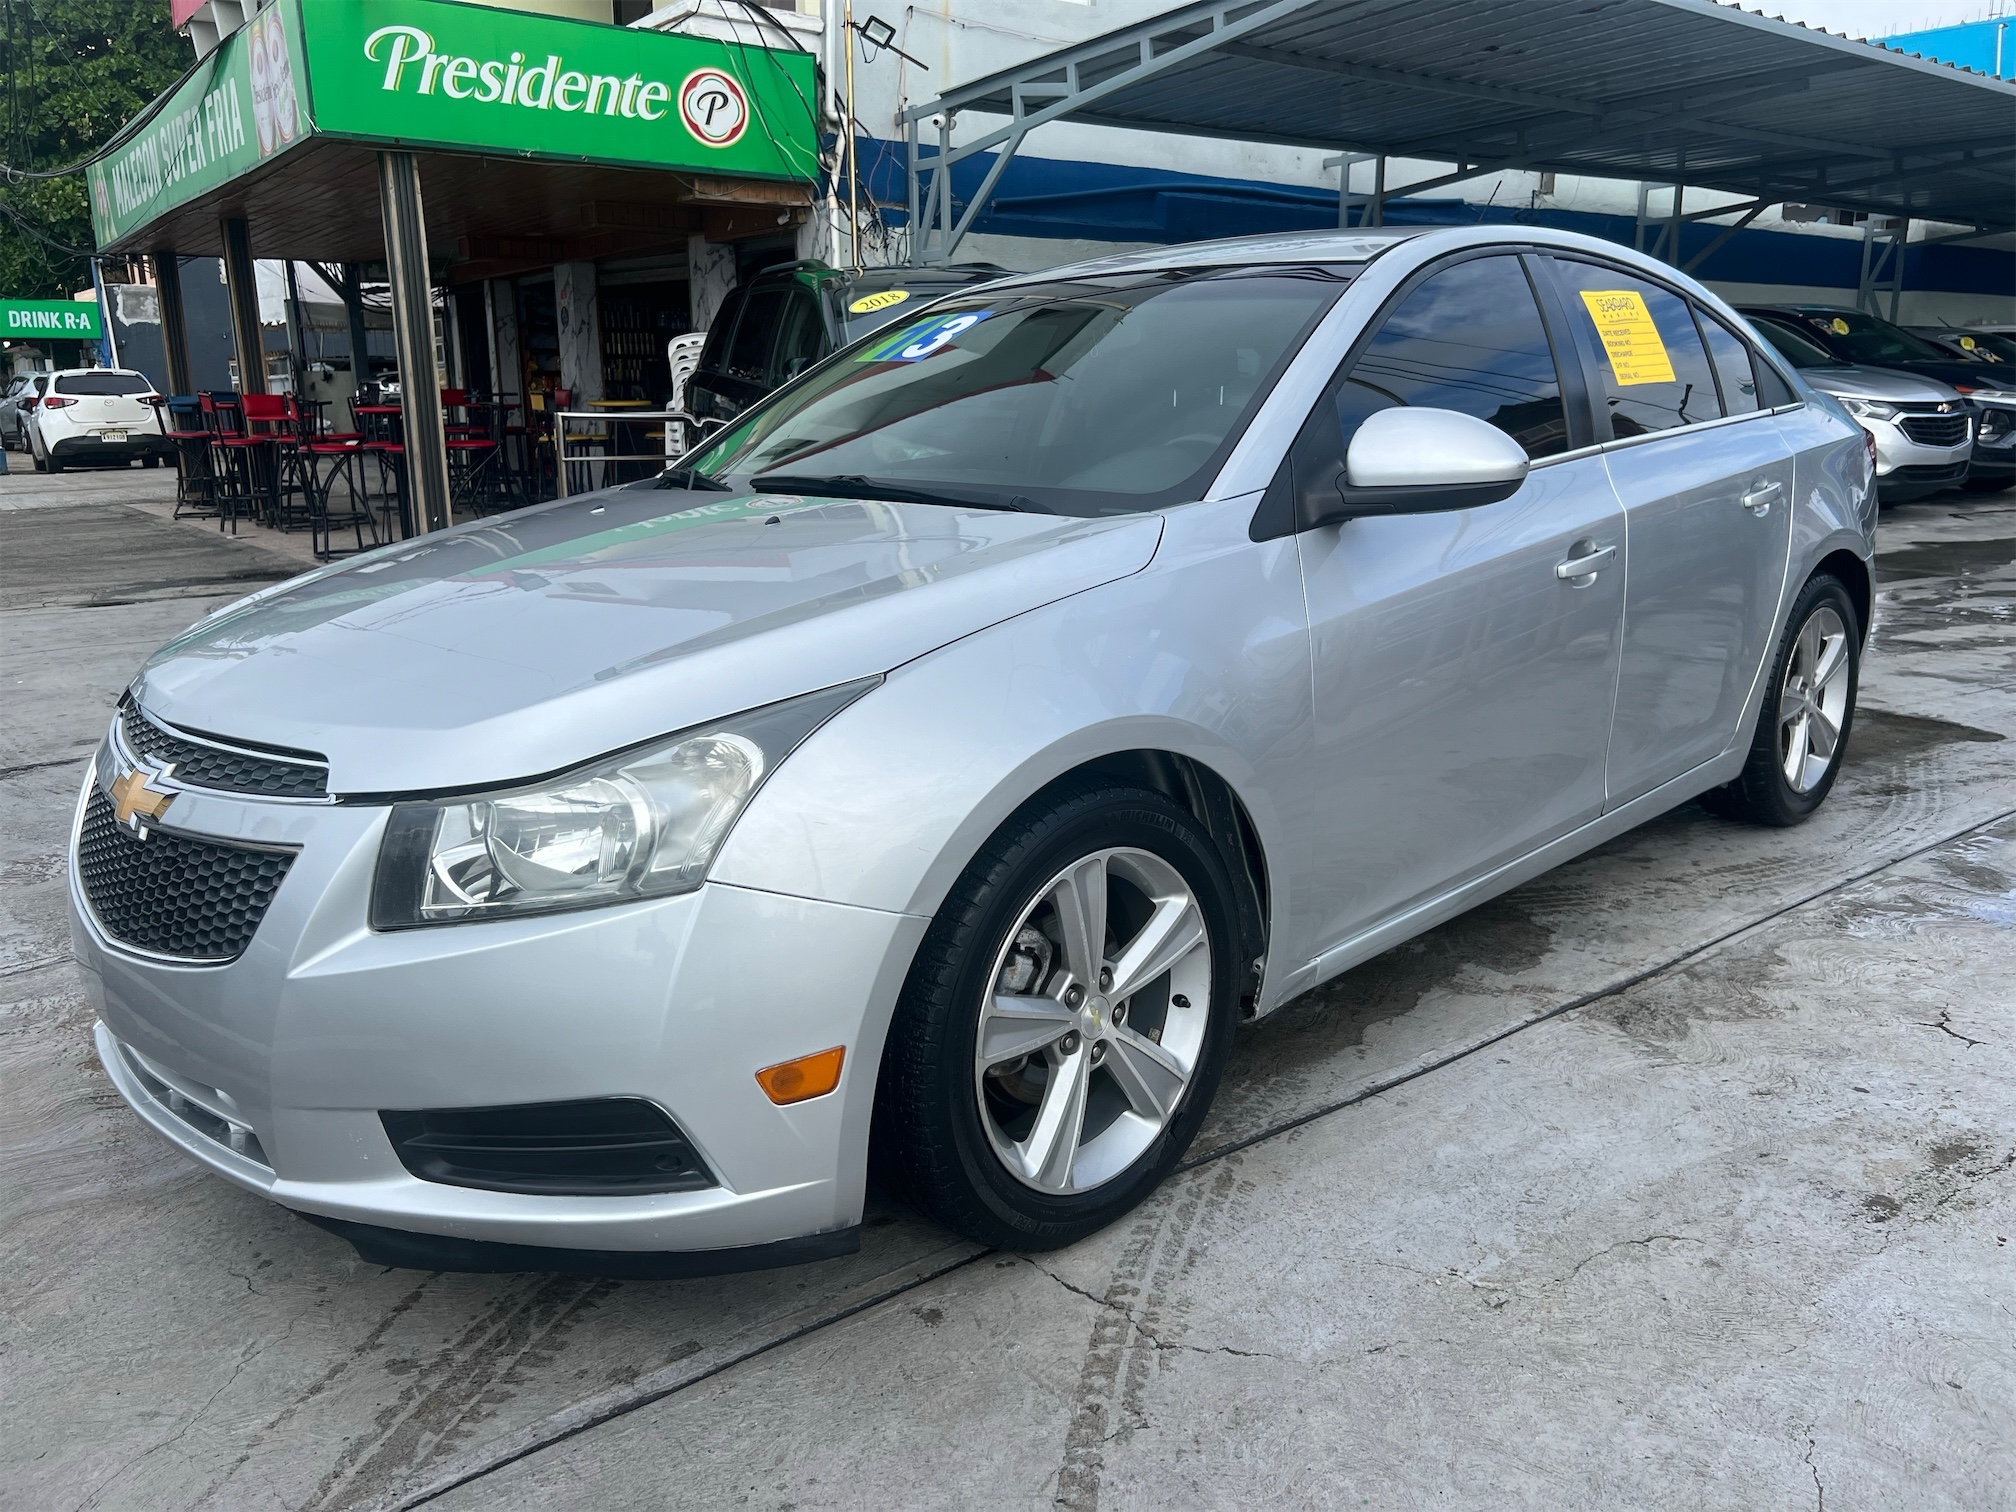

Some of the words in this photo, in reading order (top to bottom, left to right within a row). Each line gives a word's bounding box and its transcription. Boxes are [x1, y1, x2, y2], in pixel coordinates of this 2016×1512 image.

[363, 25, 671, 121] Presidente
[111, 133, 163, 219] MALECON
[160, 105, 207, 188] SUPER
[204, 77, 246, 162] FRIA
[859, 292, 901, 310] 2018
[1595, 297, 1635, 312] SEABOARD
[8, 310, 62, 329] DRINK
[64, 312, 91, 329] R-A
